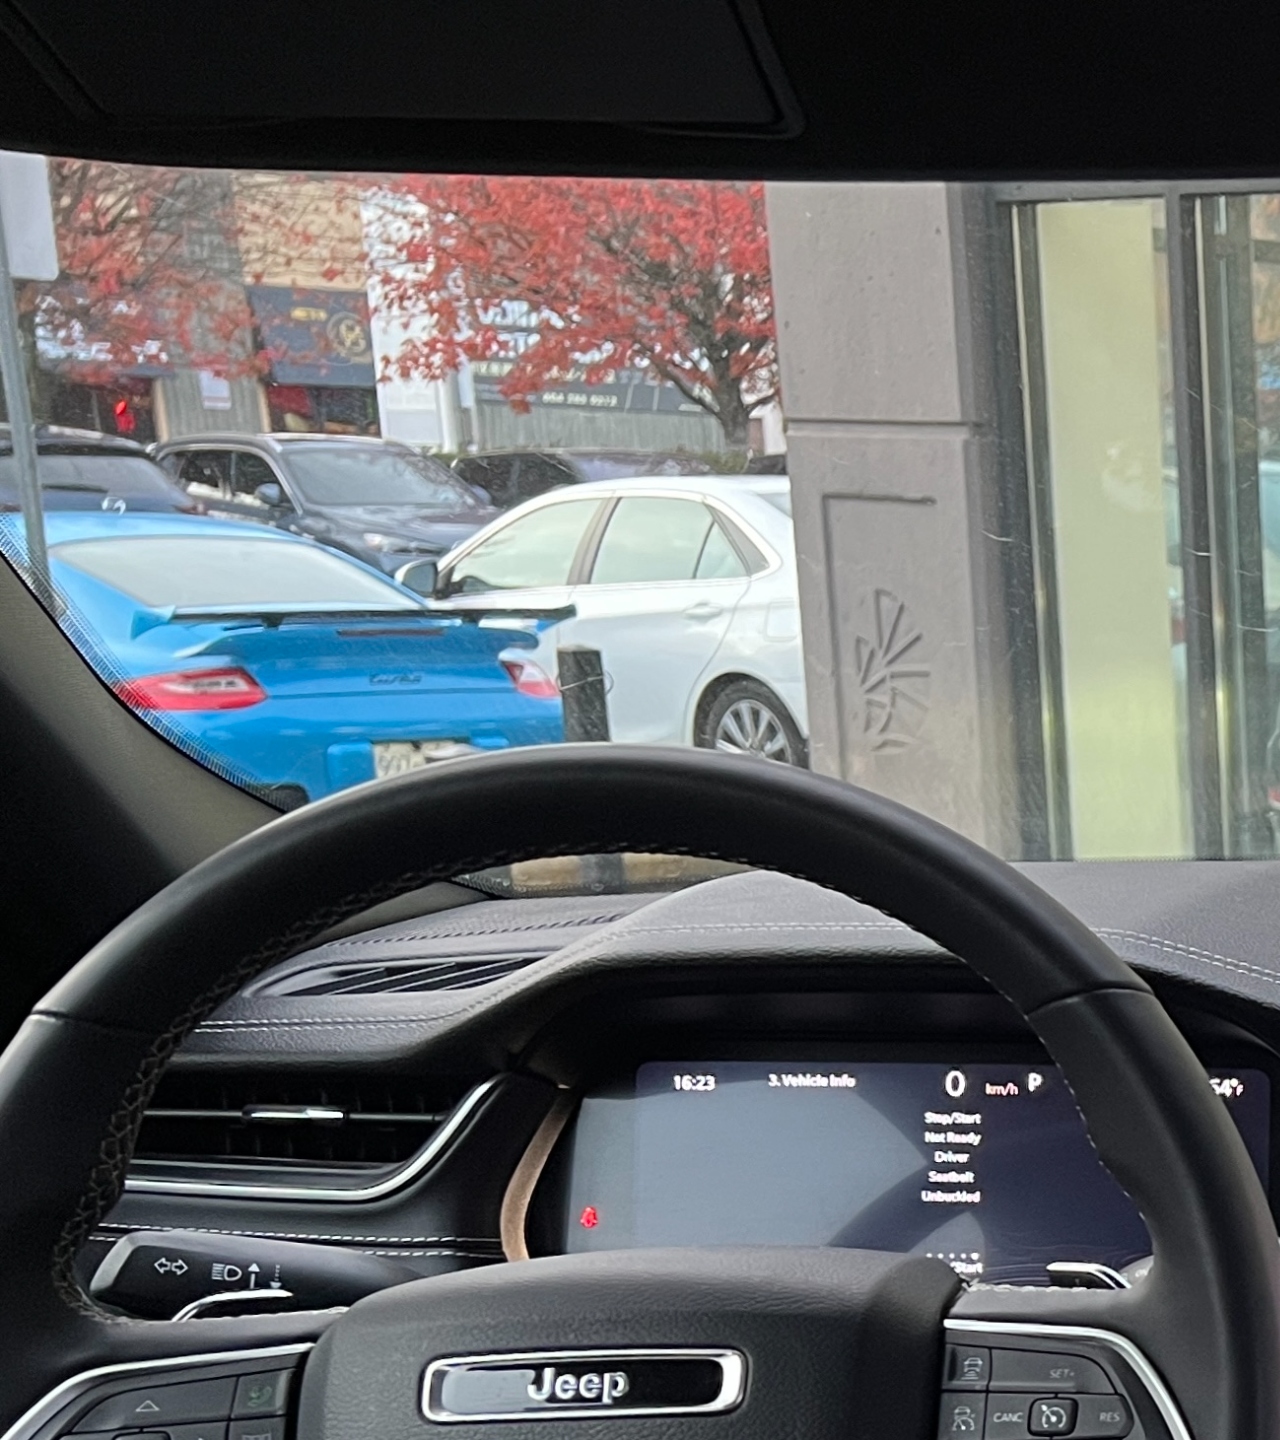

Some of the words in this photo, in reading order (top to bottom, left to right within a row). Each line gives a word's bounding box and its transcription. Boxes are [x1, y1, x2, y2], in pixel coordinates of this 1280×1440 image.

[673, 1074, 716, 1092] 16:23
[768, 1074, 780, 1088] 3.
[781, 1074, 828, 1088] Vehicle
[829, 1074, 856, 1088] Info
[945, 1070, 966, 1098] 0
[985, 1082, 1019, 1097] km/h
[1027, 1072, 1043, 1092] P
[924, 1111, 982, 1125] Stop/Start
[924, 1131, 946, 1144] Not
[947, 1131, 982, 1146] Ready
[934, 1151, 970, 1163] Driver
[928, 1170, 975, 1183] Seatbelt
[921, 1190, 981, 1203] Unbuckled
[527, 1366, 630, 1405] Jeep
[993, 1411, 1024, 1423] CANC
[1100, 1411, 1120, 1422] RES
